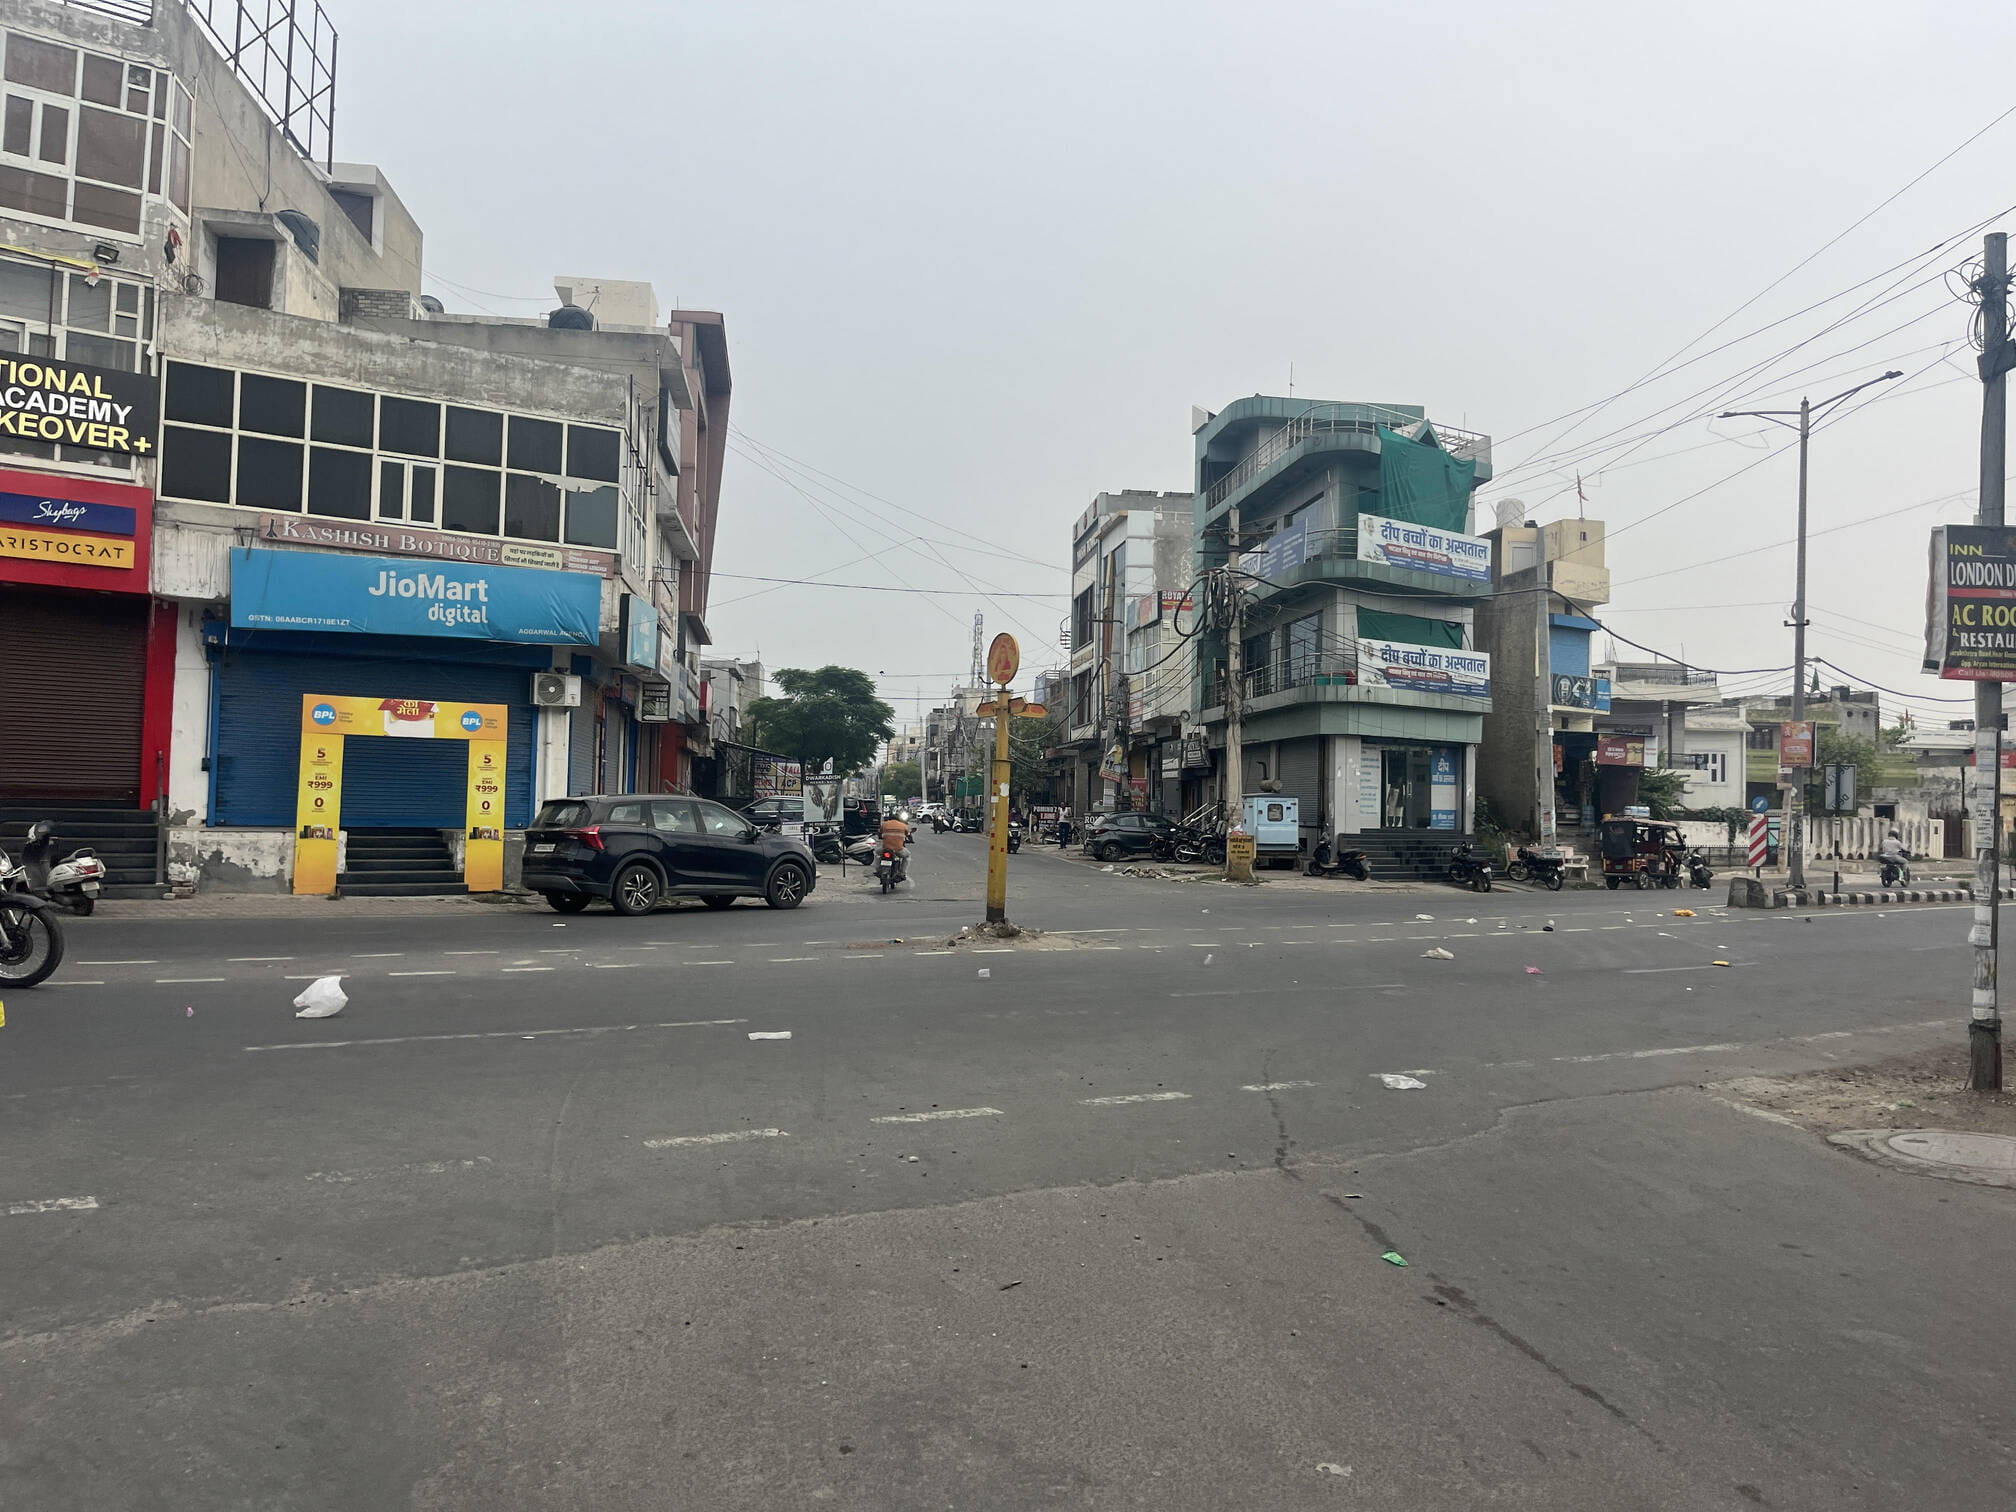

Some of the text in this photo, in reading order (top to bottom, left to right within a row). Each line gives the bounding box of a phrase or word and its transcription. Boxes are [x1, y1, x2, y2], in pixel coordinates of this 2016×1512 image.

[283, 520, 389, 549] KASHISH
[399, 534, 500, 562] BOTIQUE
[1380, 520, 1400, 542] दीप
[1402, 528, 1428, 547] बच्चों
[1428, 534, 1443, 550] का
[1445, 538, 1488, 560] अस्पताल
[1950, 543, 1983, 556] INN
[1950, 560, 2016, 587] LONDON D
[368, 570, 489, 603] JioMart
[427, 603, 489, 627] digital
[1951, 603, 1976, 627] AC
[1380, 643, 1400, 664] दीप
[1428, 653, 1443, 669] का
[1445, 655, 1487, 674] अस्पताल
[313, 710, 336, 720] BPL
[462, 718, 481, 727] BPL
